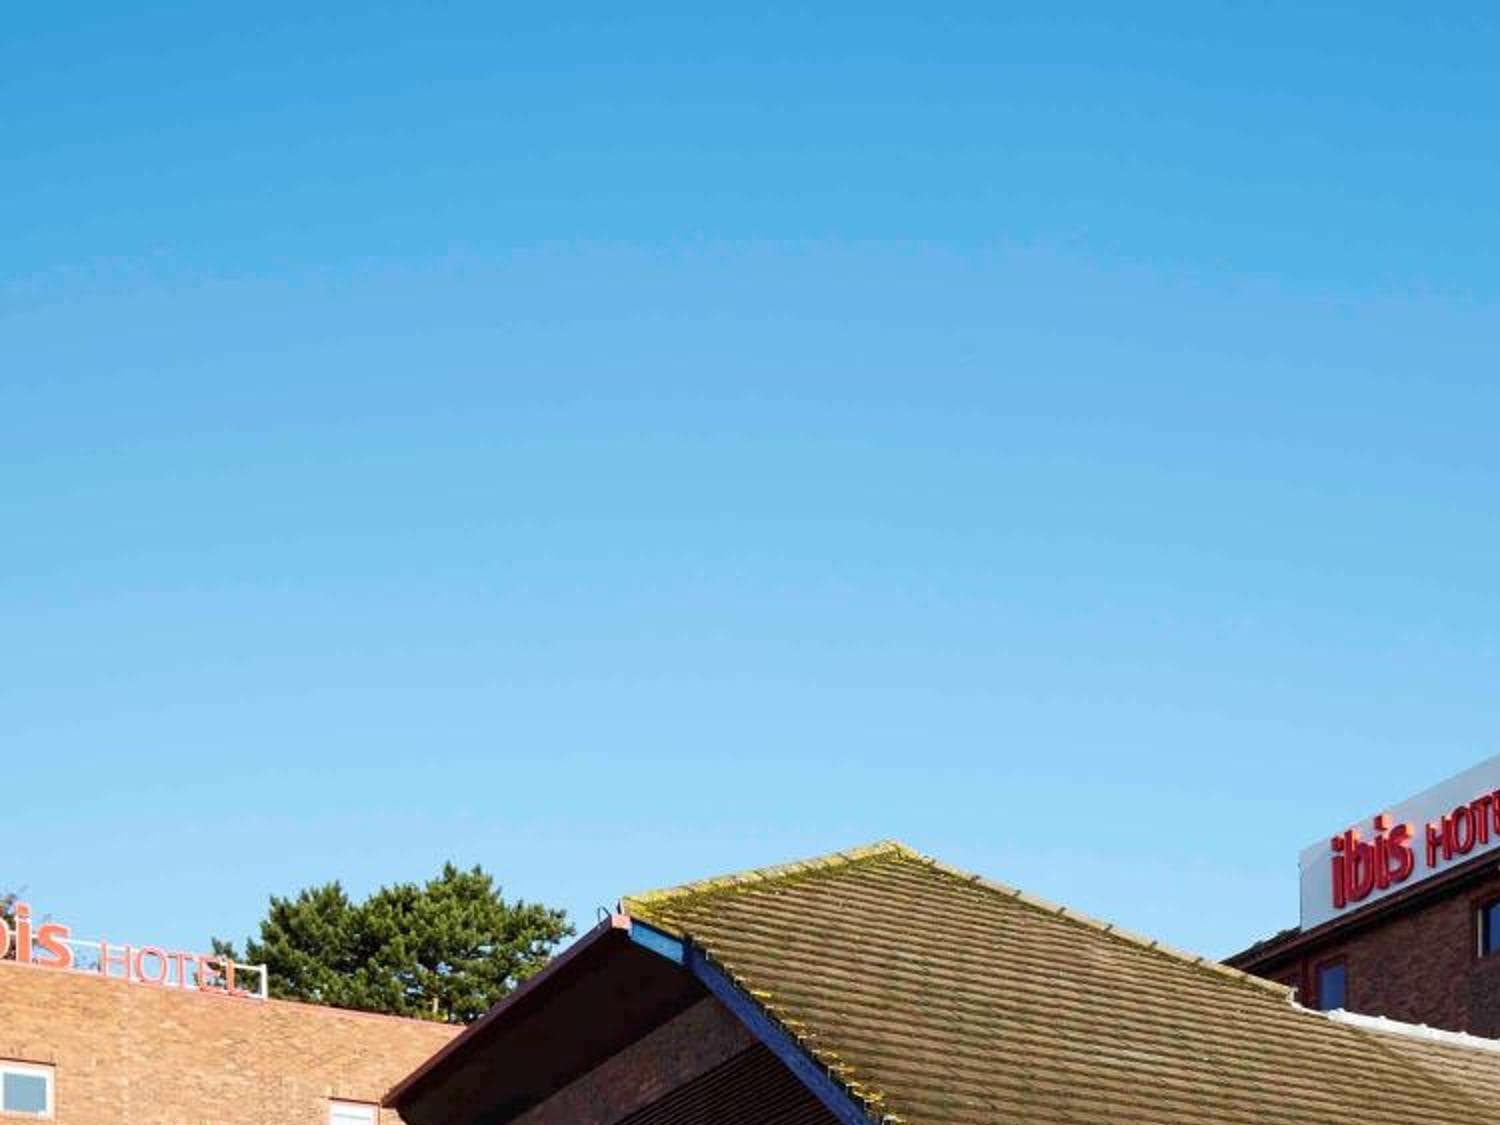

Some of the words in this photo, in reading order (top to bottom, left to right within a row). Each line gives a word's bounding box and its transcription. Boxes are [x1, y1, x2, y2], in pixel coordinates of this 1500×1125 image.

[1331, 811, 1414, 909] ibis
[0, 901, 75, 969] is
[100, 938, 250, 998] HOTEL
